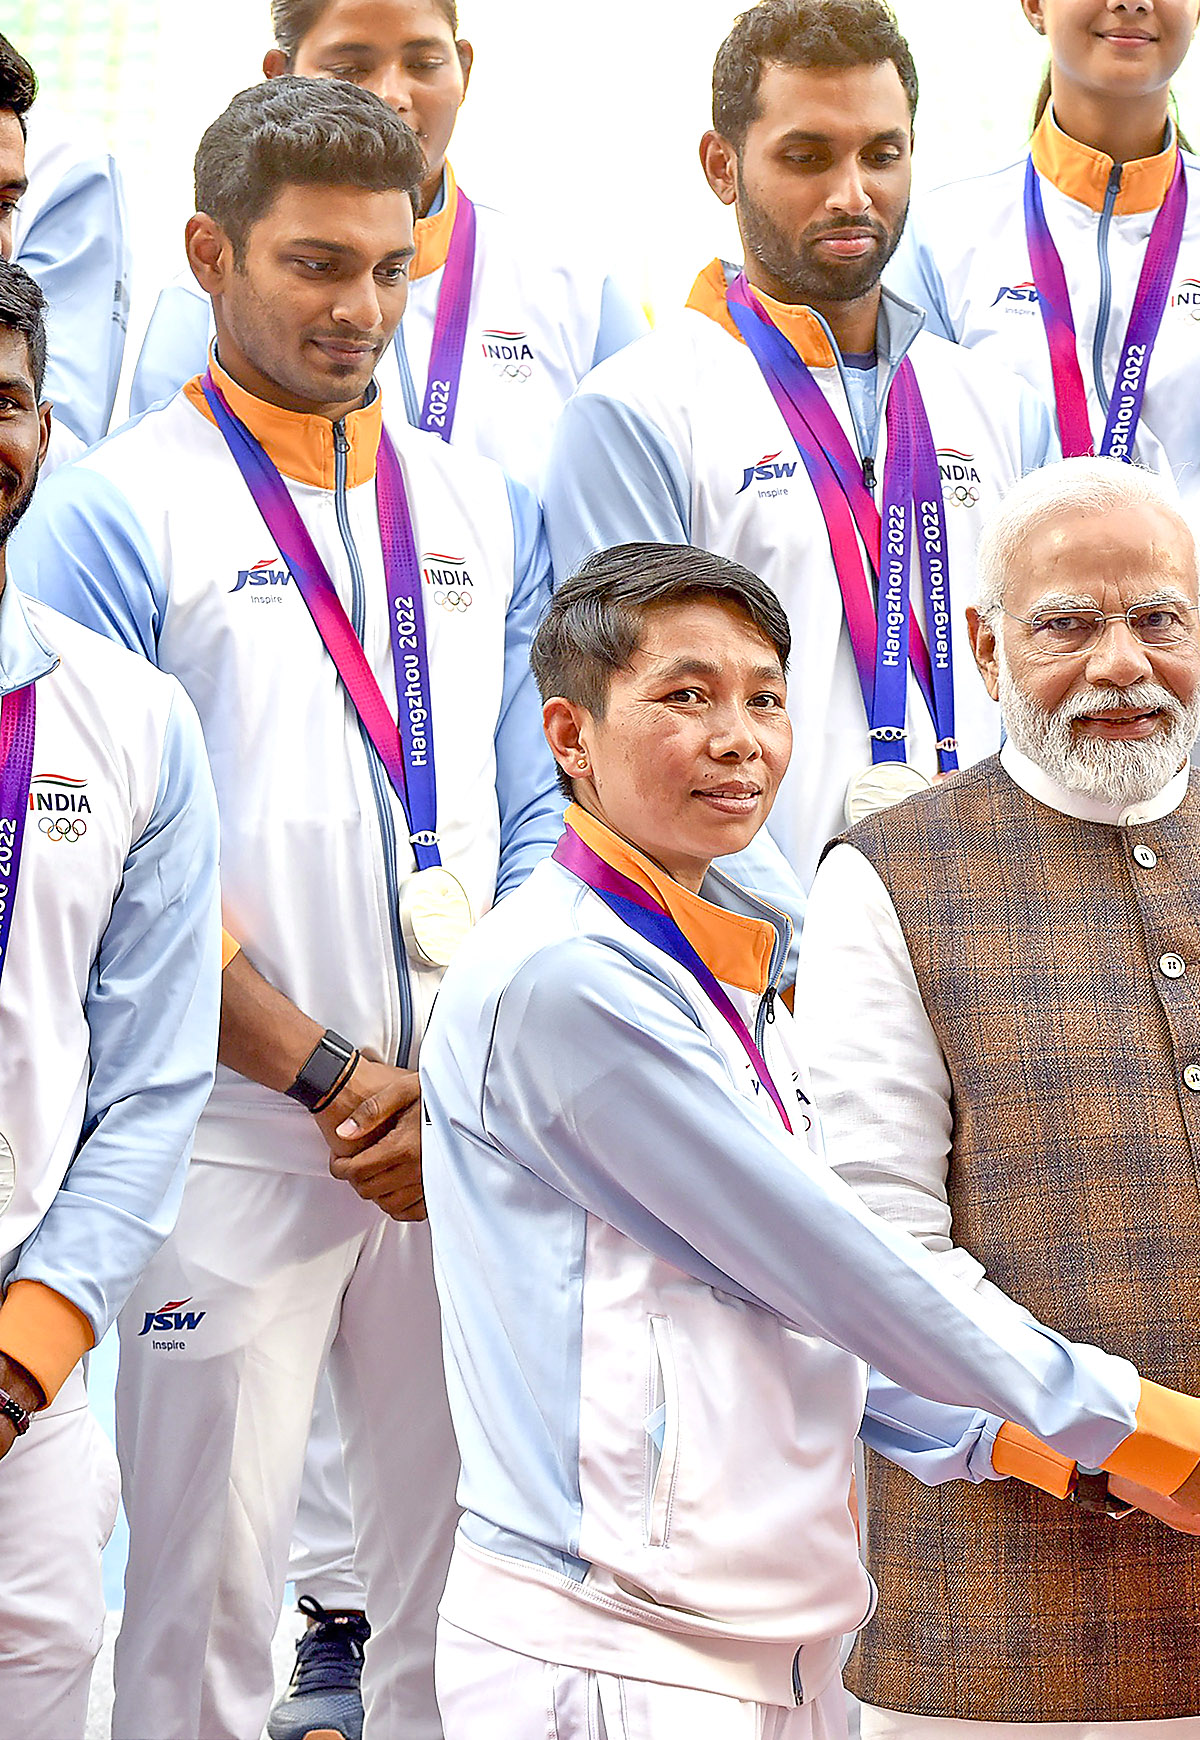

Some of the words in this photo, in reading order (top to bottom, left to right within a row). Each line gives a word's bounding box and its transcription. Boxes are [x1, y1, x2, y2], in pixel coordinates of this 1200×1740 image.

[482, 344, 534, 360] INDIA
[1121, 344, 1146, 391] 2022
[427, 380, 451, 427] 2022
[1109, 395, 1135, 458] gzhou
[735, 462, 797, 495] JSW
[938, 465, 981, 483] NDIA
[757, 487, 789, 498] Inspire
[888, 504, 905, 556] 2022
[921, 500, 942, 554] 2022
[228, 570, 291, 593] JSW
[424, 569, 474, 587] INDIA
[251, 595, 283, 604] Inspire
[883, 561, 904, 667] Hangzhou
[929, 559, 949, 669] Hangzhou
[395, 596, 418, 649] 2022
[404, 655, 428, 767] Hangzhou
[29, 793, 92, 813] INDIA
[138, 1312, 206, 1336] JSW
[153, 1340, 185, 1351] Inspire
